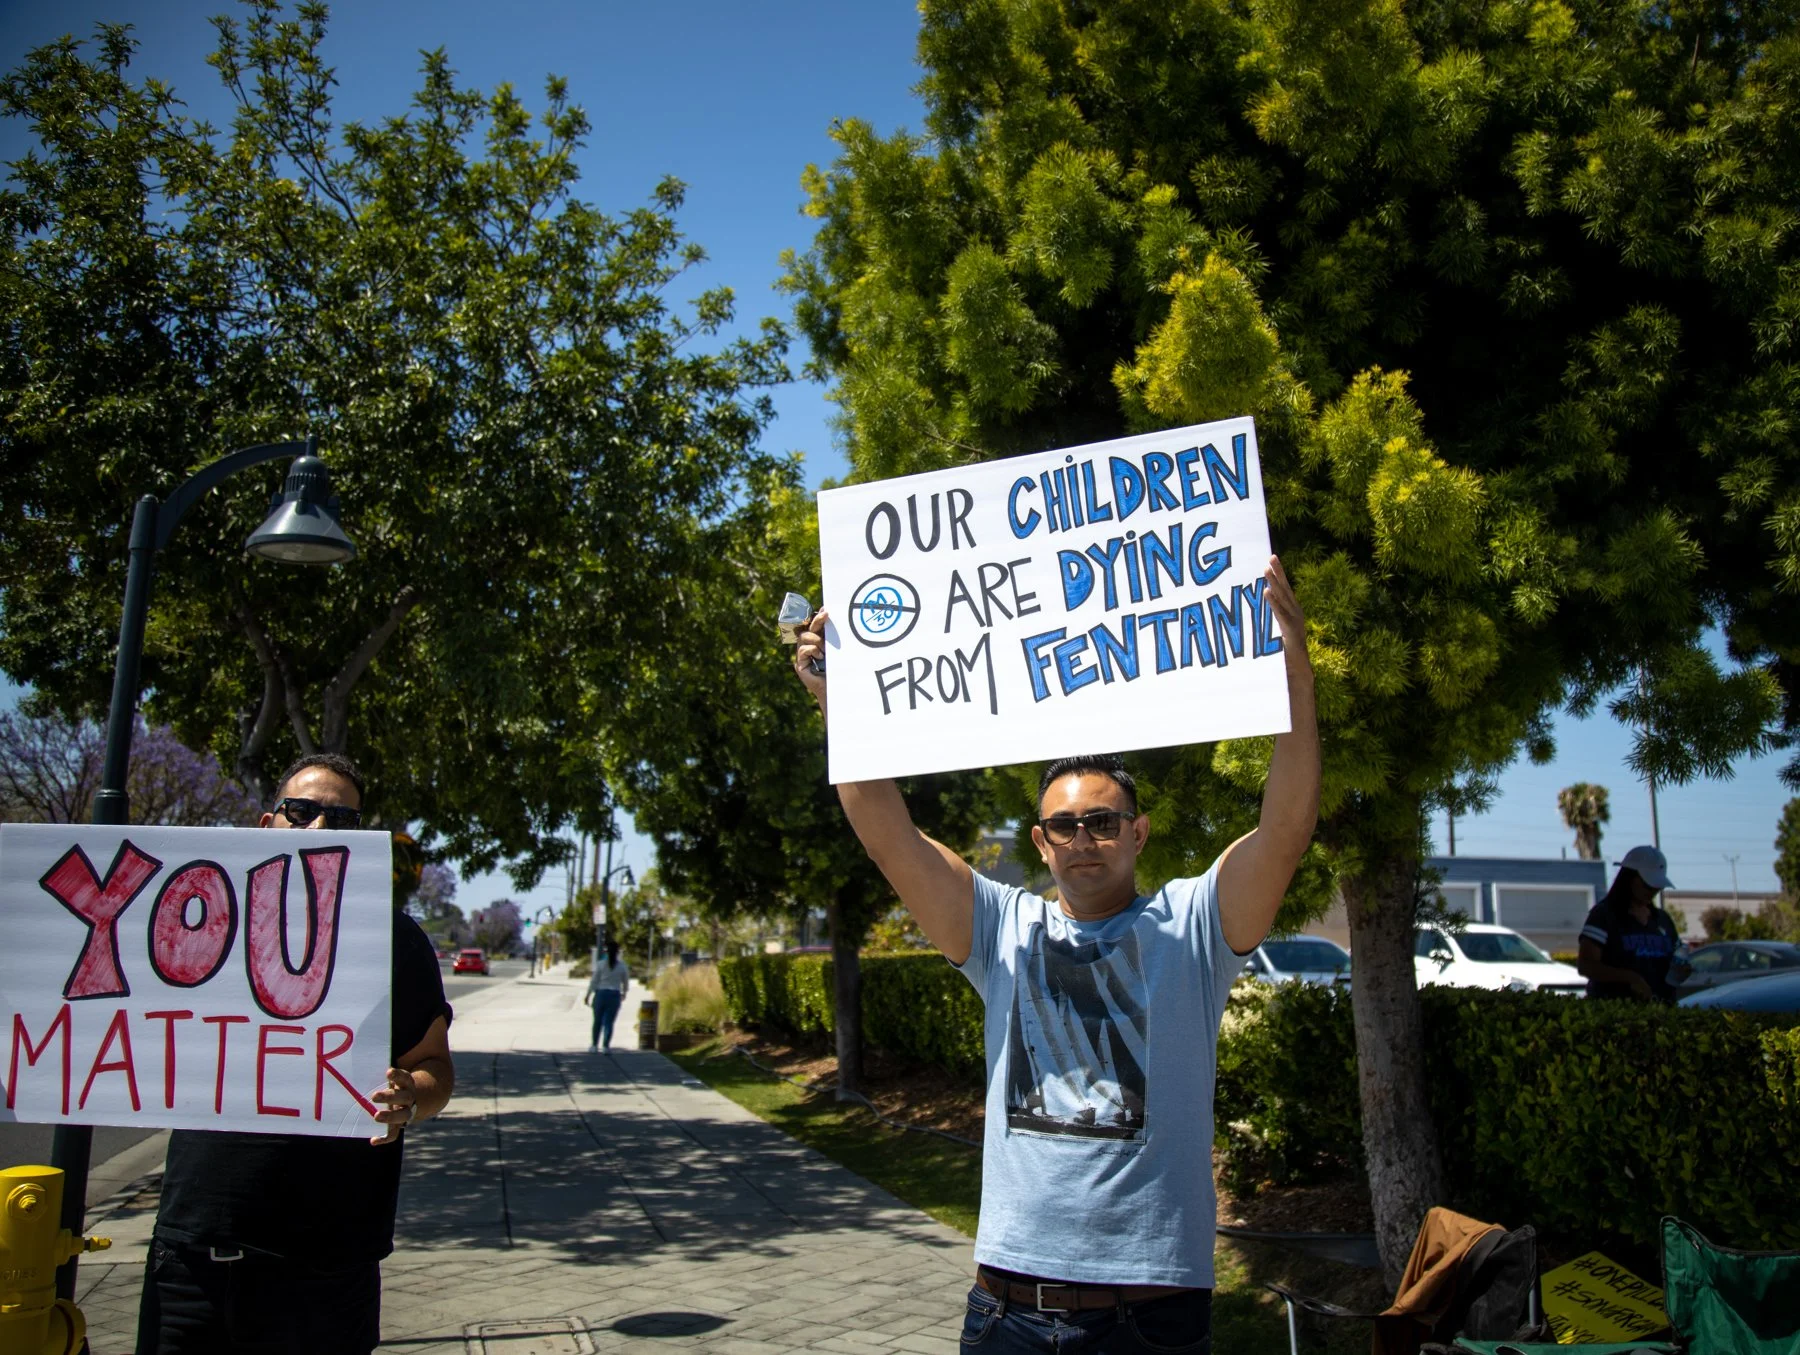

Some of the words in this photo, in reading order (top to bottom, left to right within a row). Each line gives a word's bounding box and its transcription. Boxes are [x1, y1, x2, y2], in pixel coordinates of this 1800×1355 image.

[866, 488, 977, 560] OUR
[875, 633, 998, 715] FROM
[1020, 577, 1283, 703] FENTANYL
[944, 557, 1041, 634] ARE
[38, 838, 350, 1020] YOU
[7, 1003, 379, 1121] MATTER
